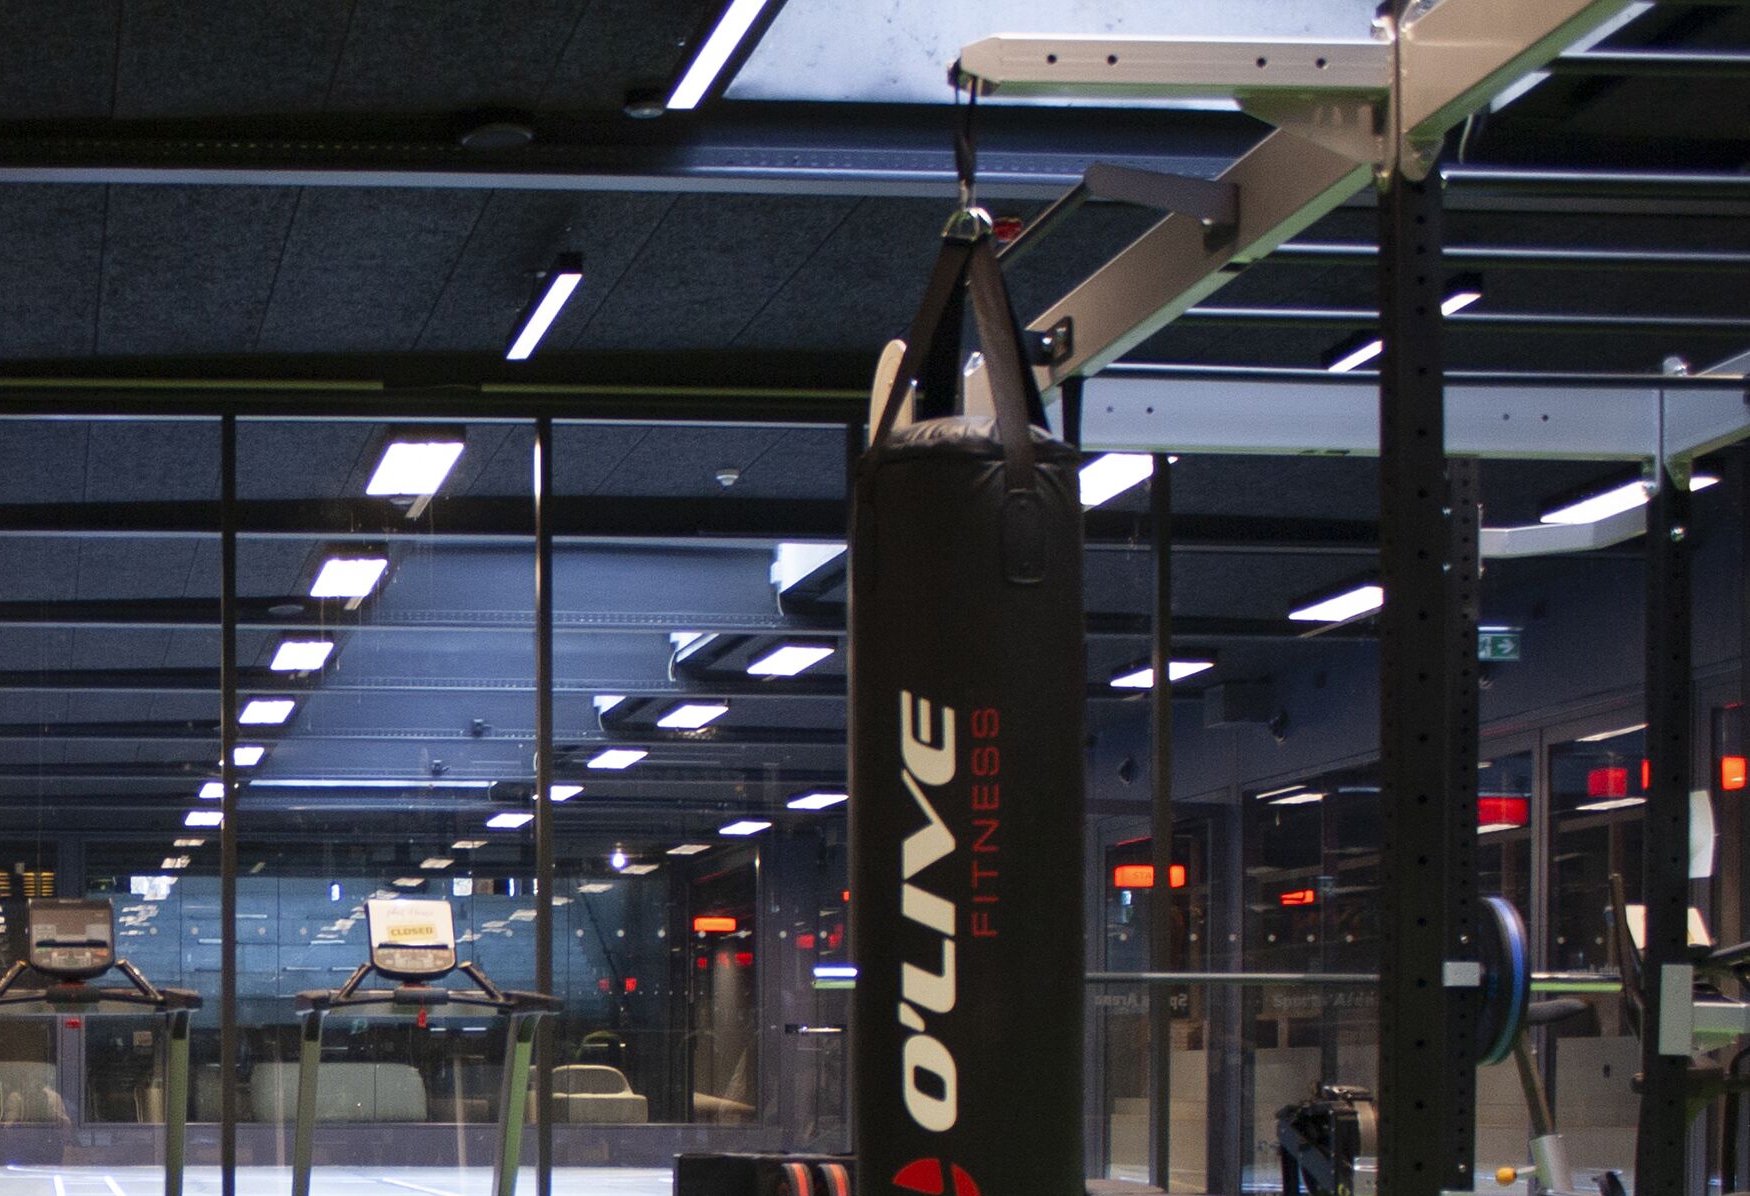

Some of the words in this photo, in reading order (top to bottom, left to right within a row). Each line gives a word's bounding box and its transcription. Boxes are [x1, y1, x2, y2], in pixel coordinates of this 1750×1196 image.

[390, 926, 434, 937] CLOSED
[900, 691, 956, 1132] O'LIVE
[971, 707, 1000, 938] FITNESS
